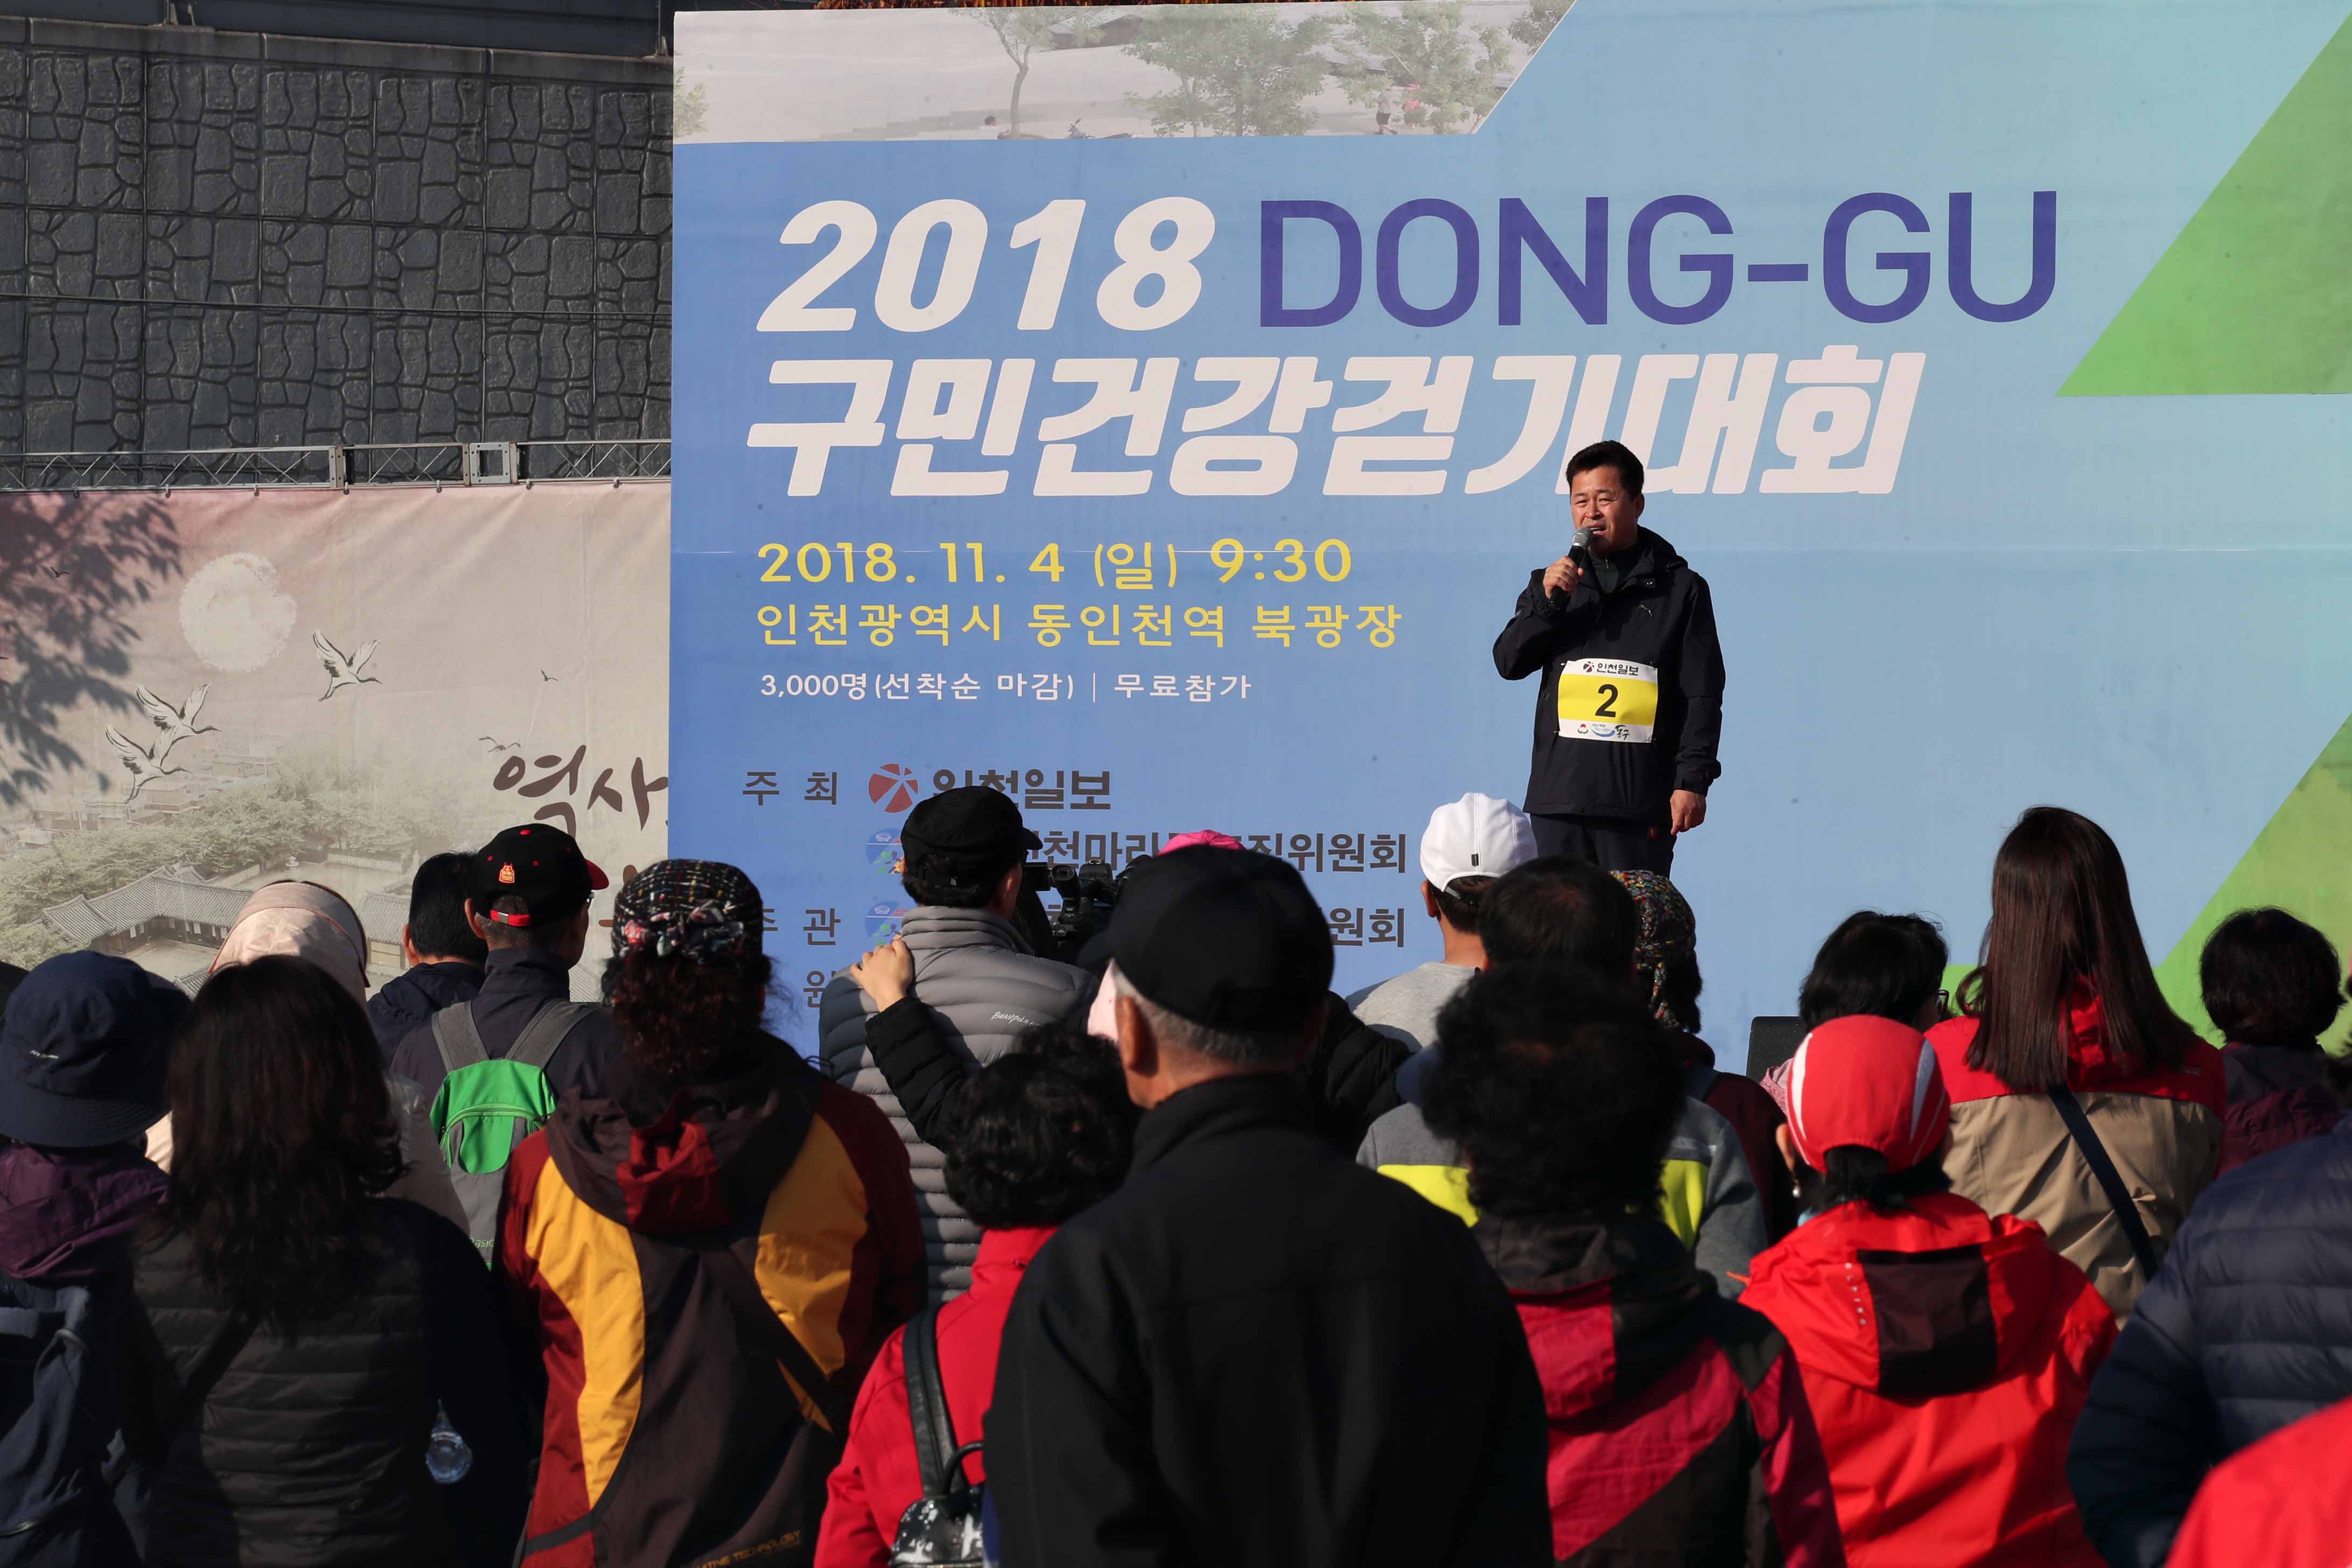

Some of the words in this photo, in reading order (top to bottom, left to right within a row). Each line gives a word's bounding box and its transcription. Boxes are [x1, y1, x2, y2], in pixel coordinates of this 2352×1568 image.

[757, 197, 1215, 332] 2018
[1260, 191, 2056, 327] DONG-GU
[747, 345, 1926, 496] 구민건강걷기대회
[758, 542, 915, 583] 2018.
[940, 542, 1005, 583] 11.
[1029, 543, 1065, 582] 4
[1094, 542, 1177, 590] (일)
[1210, 538, 1352, 583] 9:30
[757, 604, 1000, 647] 인천광역시
[1028, 604, 1223, 648] 동인천역
[1252, 604, 1402, 648] 북광장
[997, 673, 1074, 701] 마감)
[1114, 674, 1252, 702] 무료참가
[1597, 662, 1639, 676] 인천일보
[1594, 684, 1619, 718] 2
